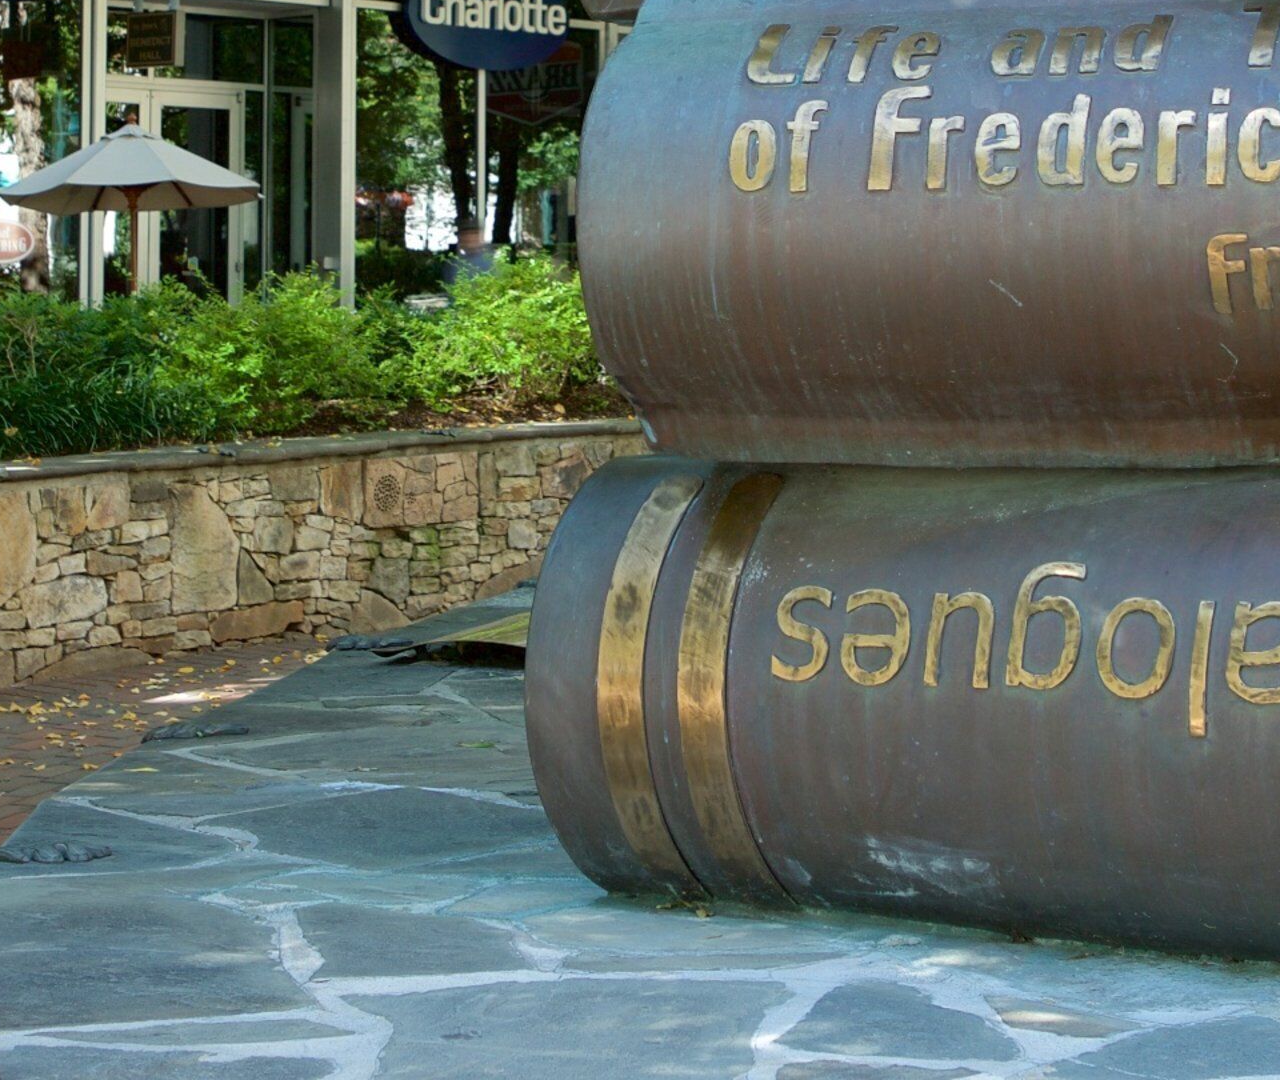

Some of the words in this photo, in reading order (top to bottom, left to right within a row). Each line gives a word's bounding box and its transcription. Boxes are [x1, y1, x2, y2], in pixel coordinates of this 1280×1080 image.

[744, 21, 943, 87] Life
[989, 13, 1176, 78] and
[728, 98, 830, 194] of
